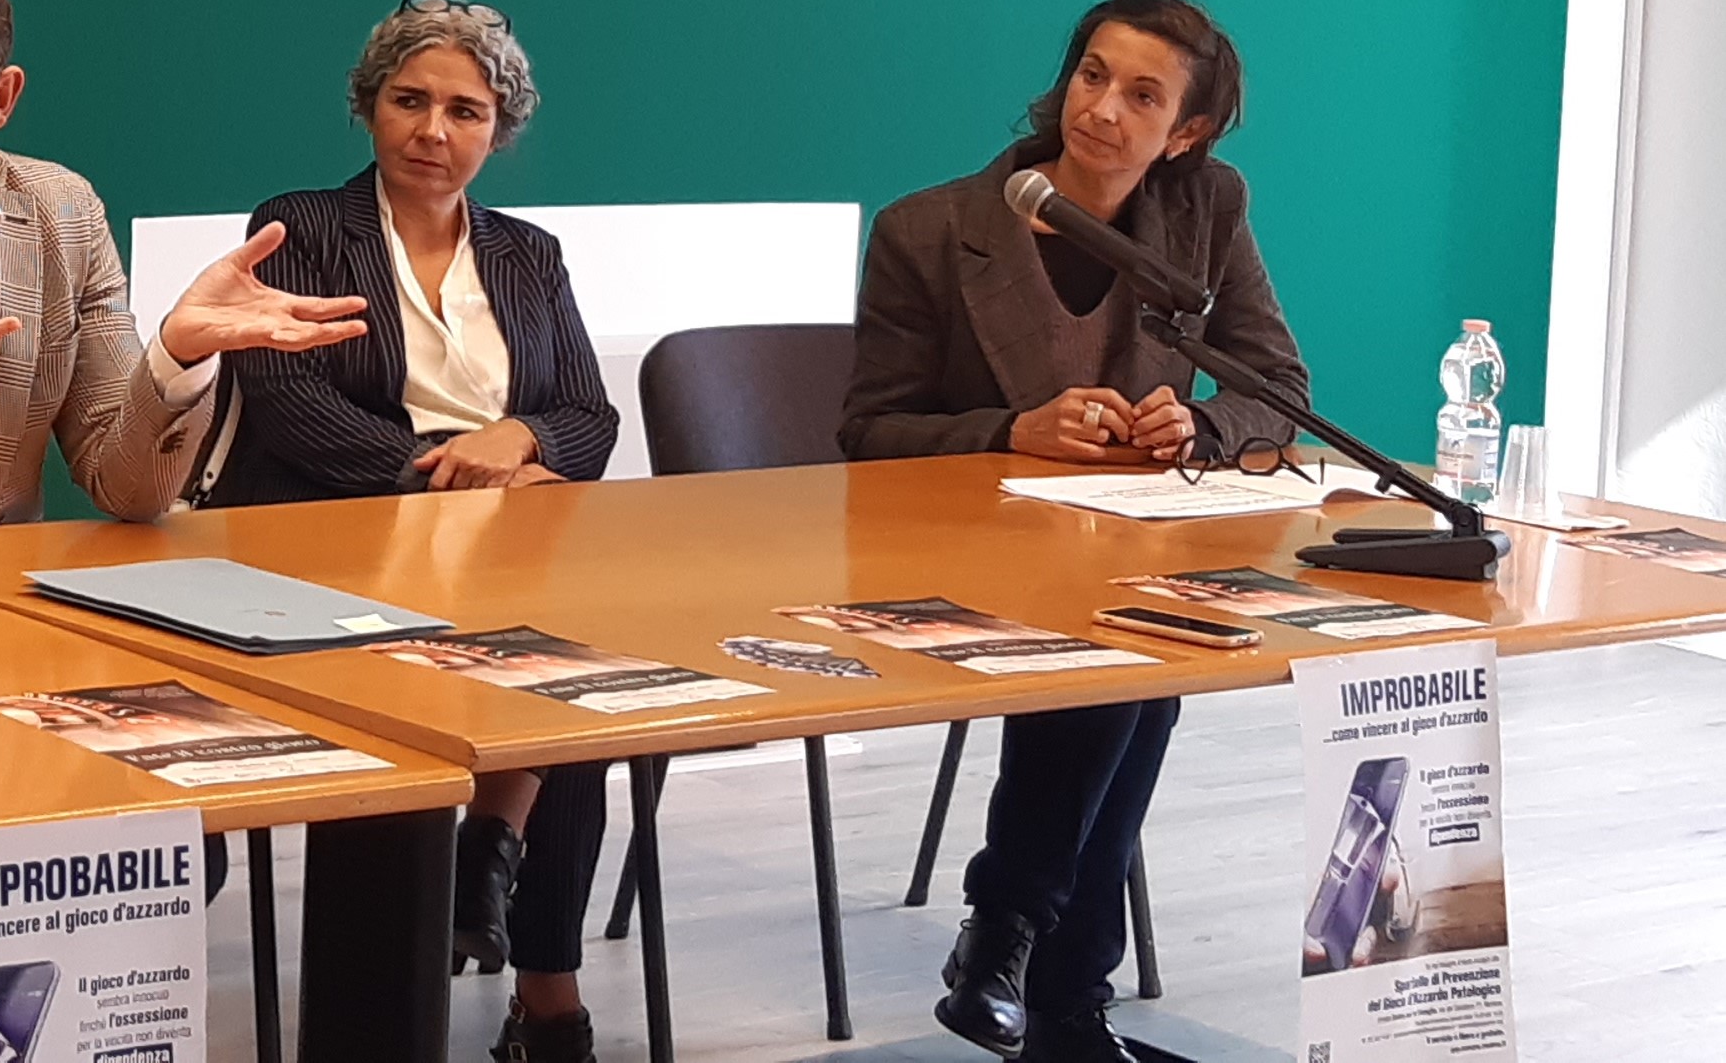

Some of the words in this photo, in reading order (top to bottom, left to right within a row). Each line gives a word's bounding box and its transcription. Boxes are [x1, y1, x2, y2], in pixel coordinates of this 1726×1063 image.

[1340, 668, 1486, 717] IMPROBABILE
[1401, 717, 1410, 733] al
[45, 912, 61, 931] al
[66, 908, 108, 934] gioco
[113, 896, 190, 922] d'azzardo
[78, 976, 87, 992] Il
[90, 975, 124, 996] gioco
[126, 965, 190, 986] d'azzardo
[109, 1006, 188, 1028] l'ossessione
